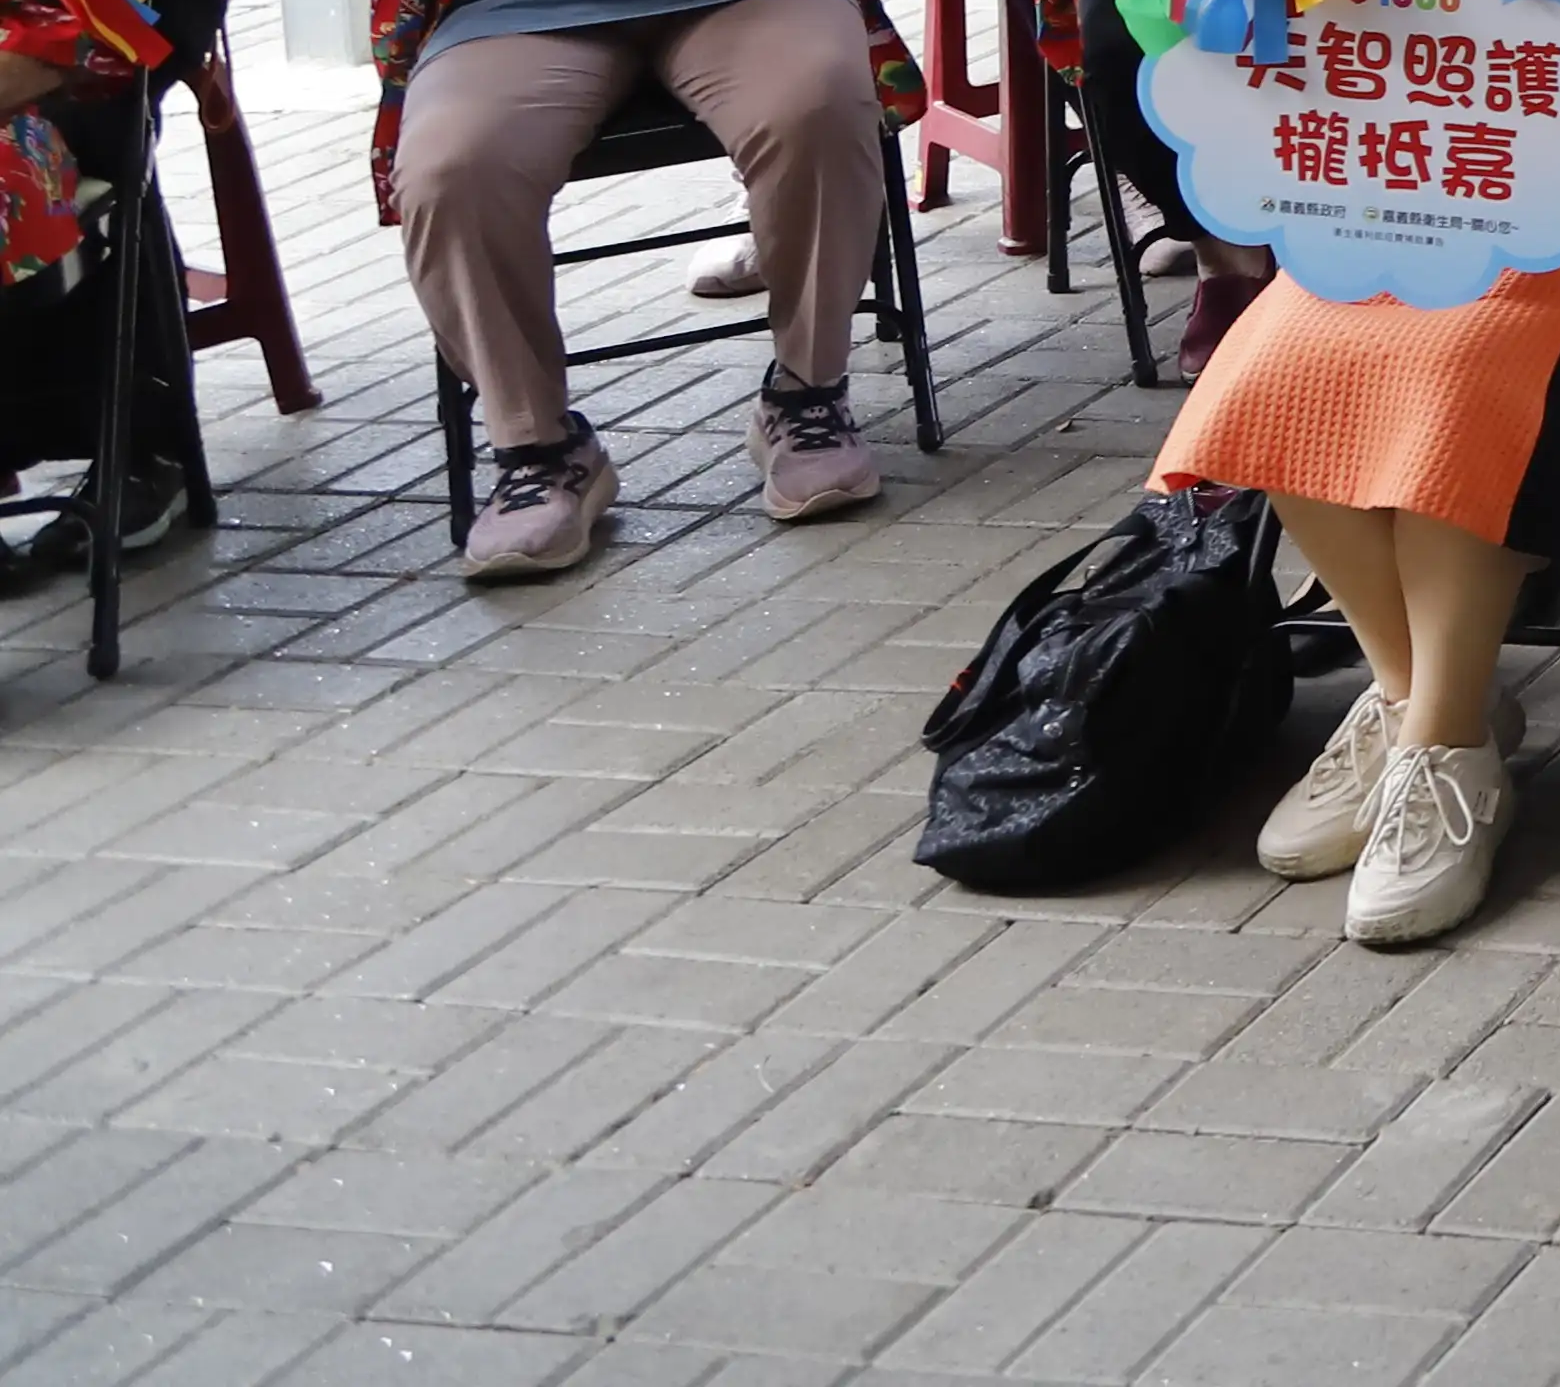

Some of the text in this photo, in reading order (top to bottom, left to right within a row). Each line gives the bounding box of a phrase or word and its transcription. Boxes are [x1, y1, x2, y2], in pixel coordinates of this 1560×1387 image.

[1272, 108, 1519, 202] 攏抵嘉
[1279, 199, 1347, 220] 嘉義縣政府
